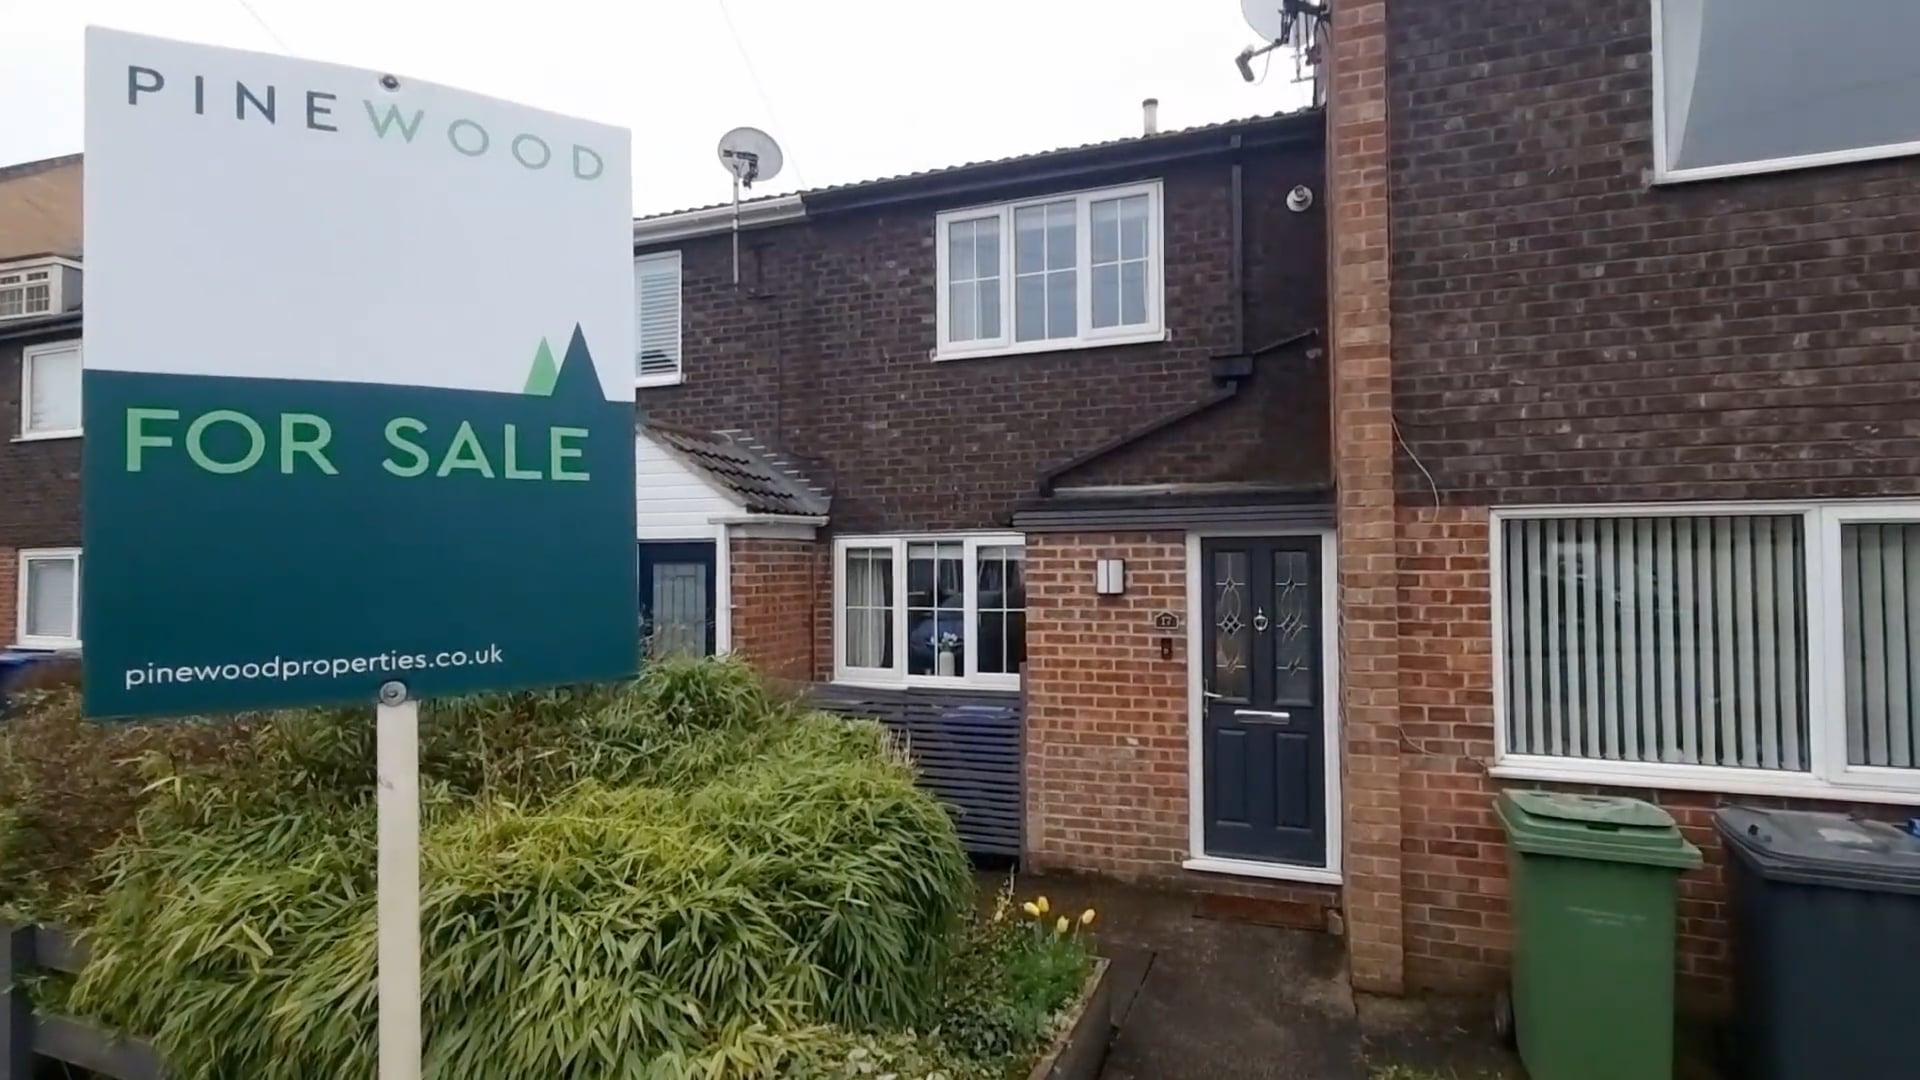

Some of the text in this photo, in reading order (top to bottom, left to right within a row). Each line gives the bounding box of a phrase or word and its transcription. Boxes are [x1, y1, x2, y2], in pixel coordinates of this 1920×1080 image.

[128, 65, 603, 180] PINEWOOD
[126, 408, 590, 481] FOR SALE
[1161, 616, 1172, 626] 17
[126, 643, 503, 689] pinewoodproperties.co.uk
